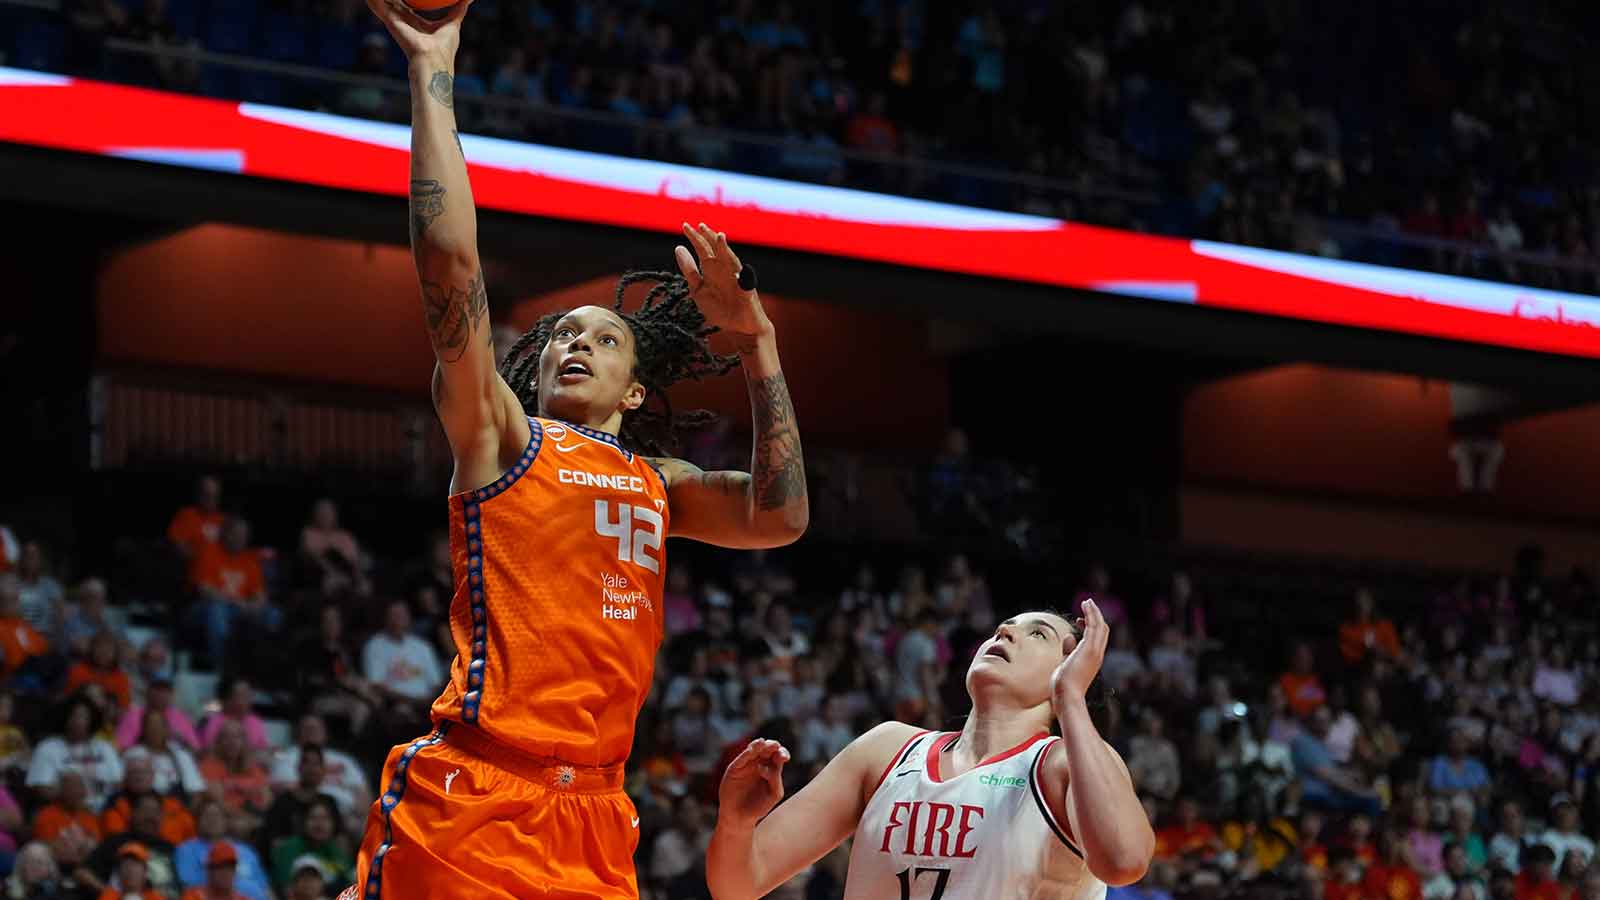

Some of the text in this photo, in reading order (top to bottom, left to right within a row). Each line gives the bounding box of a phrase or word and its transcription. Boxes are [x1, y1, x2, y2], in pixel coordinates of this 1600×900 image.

[594, 499, 664, 575] 42
[600, 572, 628, 588] Yale
[602, 604, 638, 620] Heal
[880, 801, 984, 858] FIRE
[896, 866, 951, 900] 17
